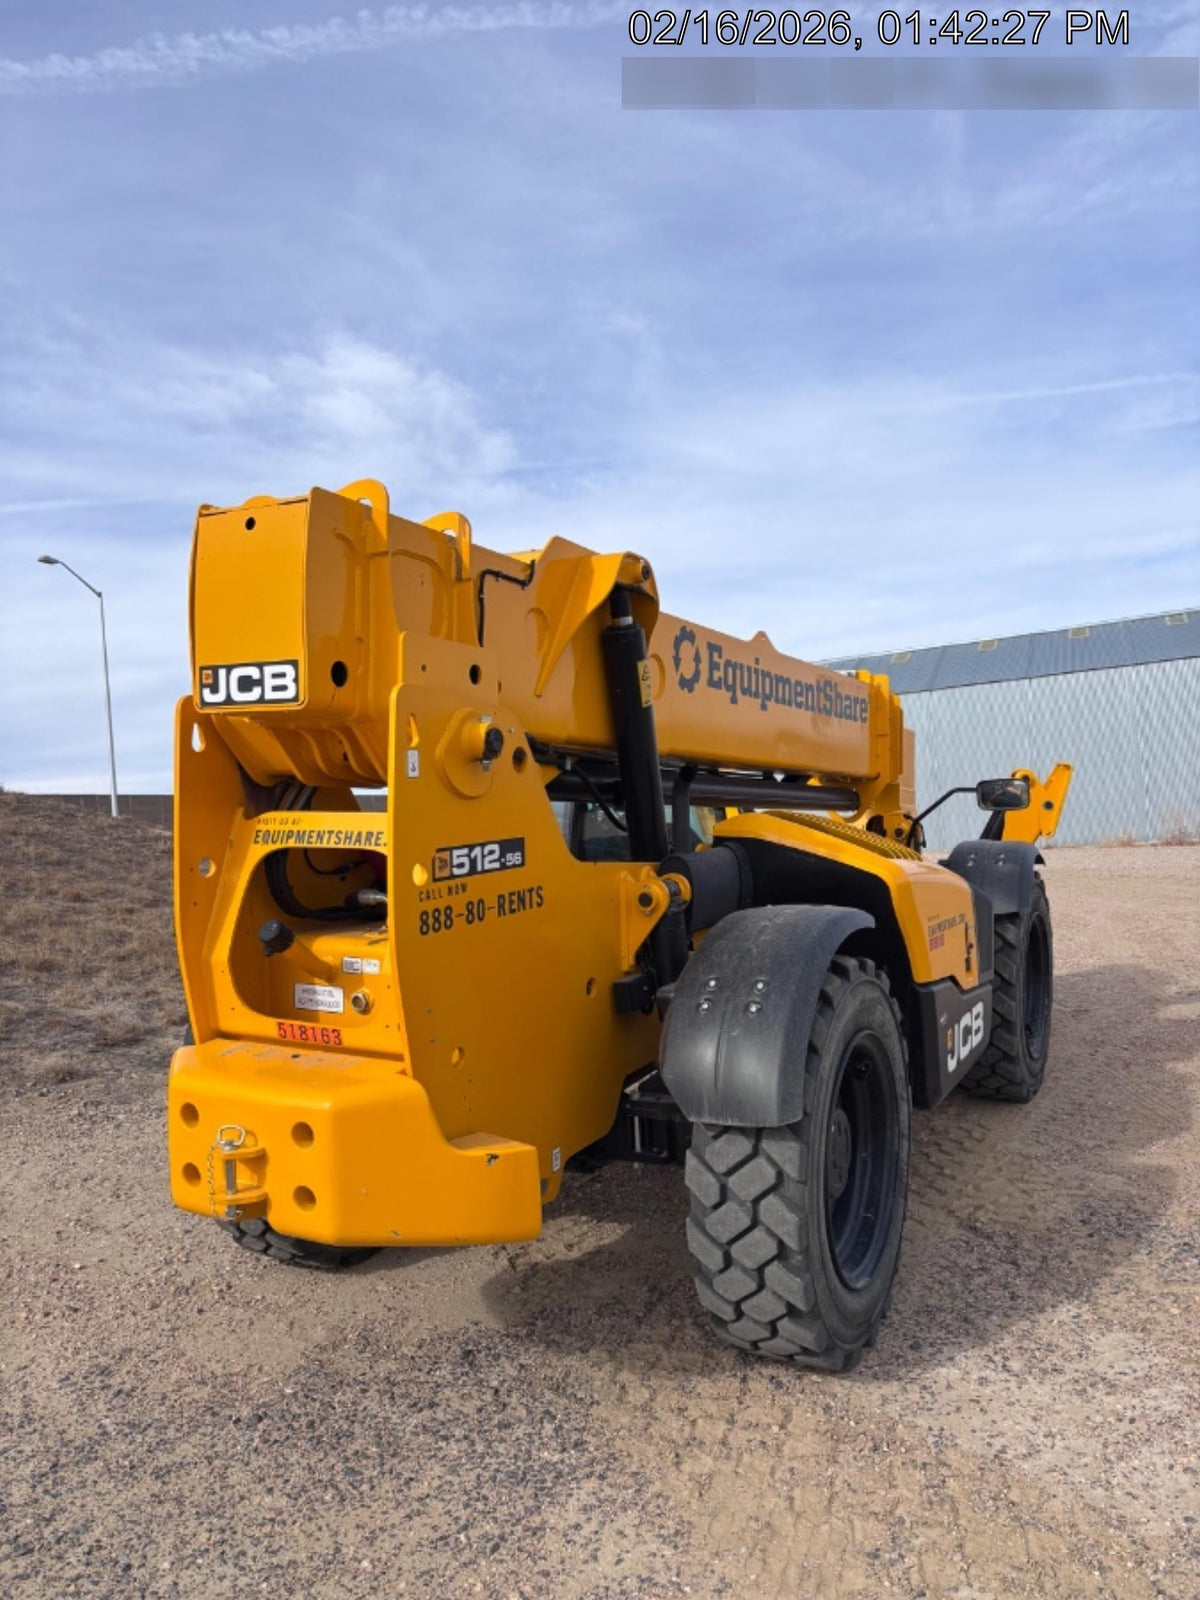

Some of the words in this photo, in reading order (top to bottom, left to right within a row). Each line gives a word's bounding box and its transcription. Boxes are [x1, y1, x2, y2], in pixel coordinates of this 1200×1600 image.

[202, 664, 297, 703] JCB
[707, 641, 868, 723] EquipmentShare
[419, 887, 443, 902] CALL
[447, 883, 468, 897] NOW
[419, 885, 544, 936] 888-80-RENTS
[277, 1021, 342, 1046] 518163
[947, 1001, 984, 1073] JCB
